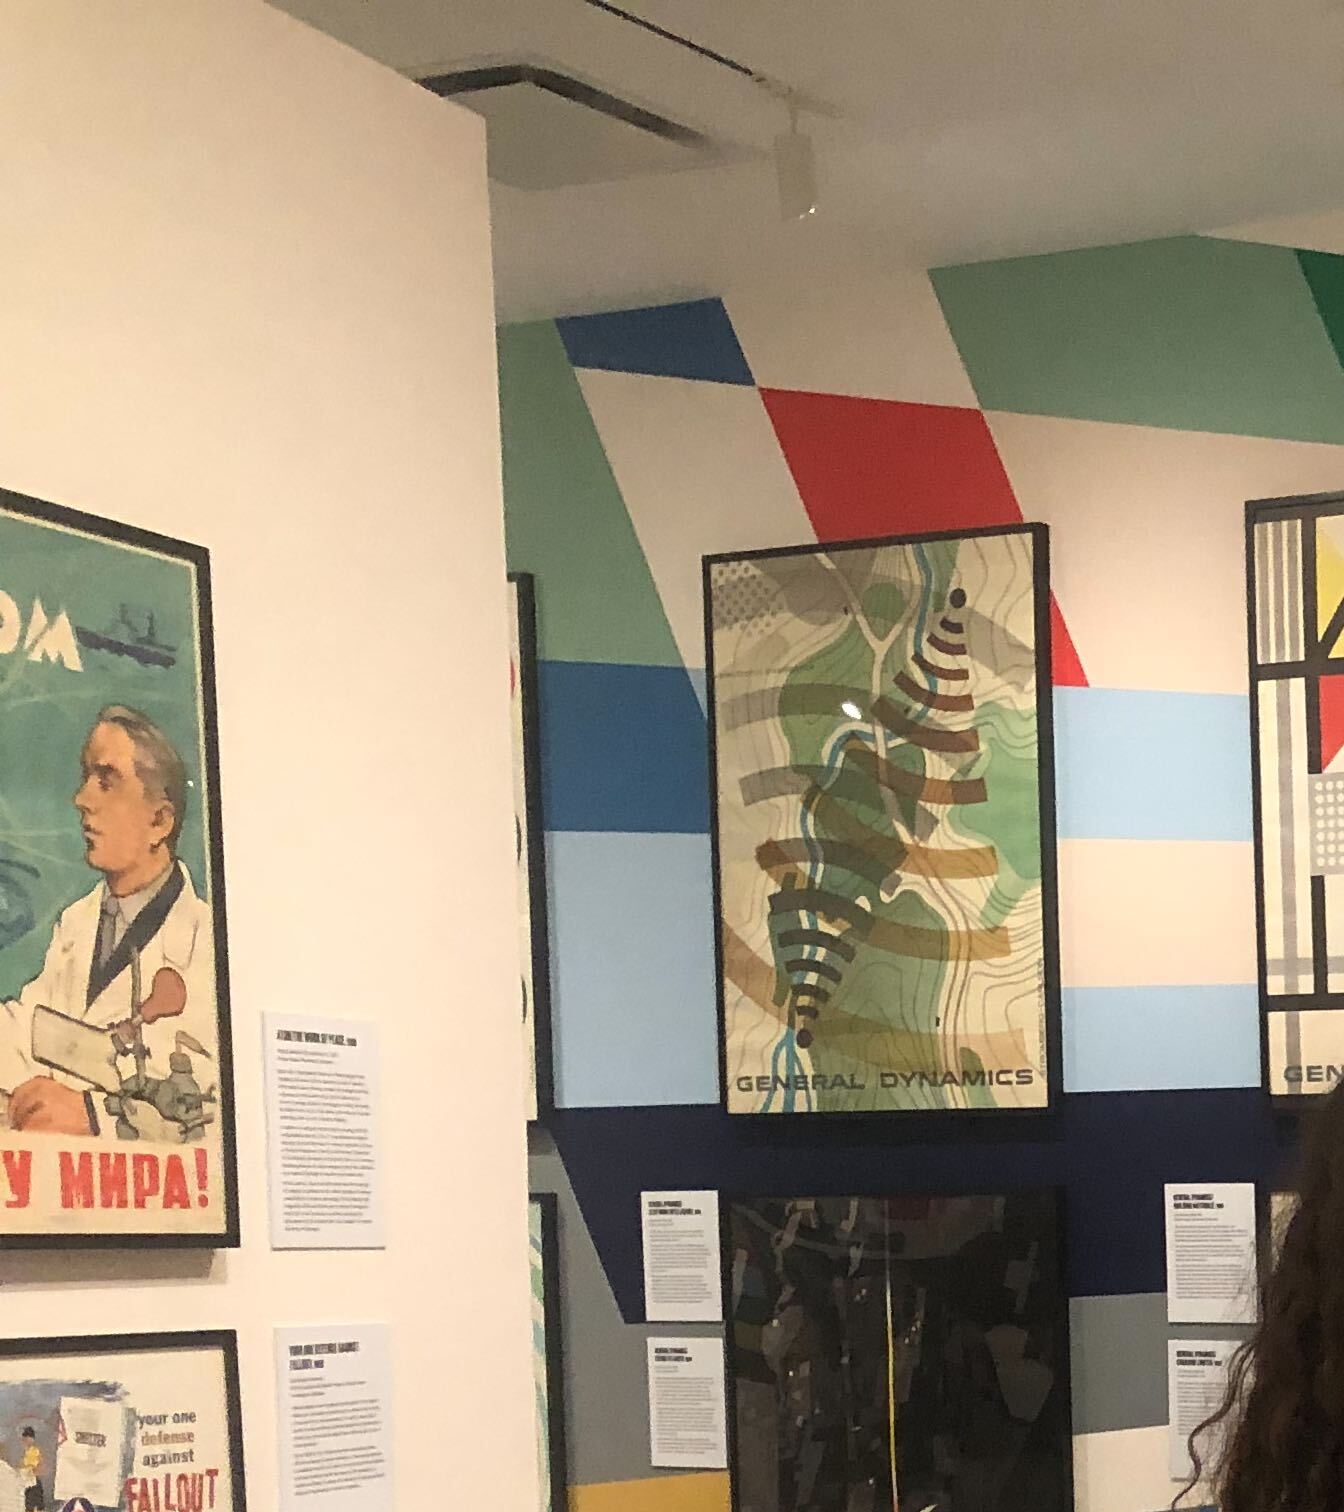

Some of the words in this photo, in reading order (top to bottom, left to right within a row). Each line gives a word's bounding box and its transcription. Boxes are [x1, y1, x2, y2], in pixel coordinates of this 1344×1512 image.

[736, 1074, 866, 1092] GENERAL
[880, 1068, 1034, 1088] DYNAMICS
[59, 1148, 209, 1210] МИРА!
[138, 1414, 169, 1428] your
[172, 1411, 197, 1424] one
[141, 1430, 195, 1446] defense
[142, 1449, 195, 1468] against
